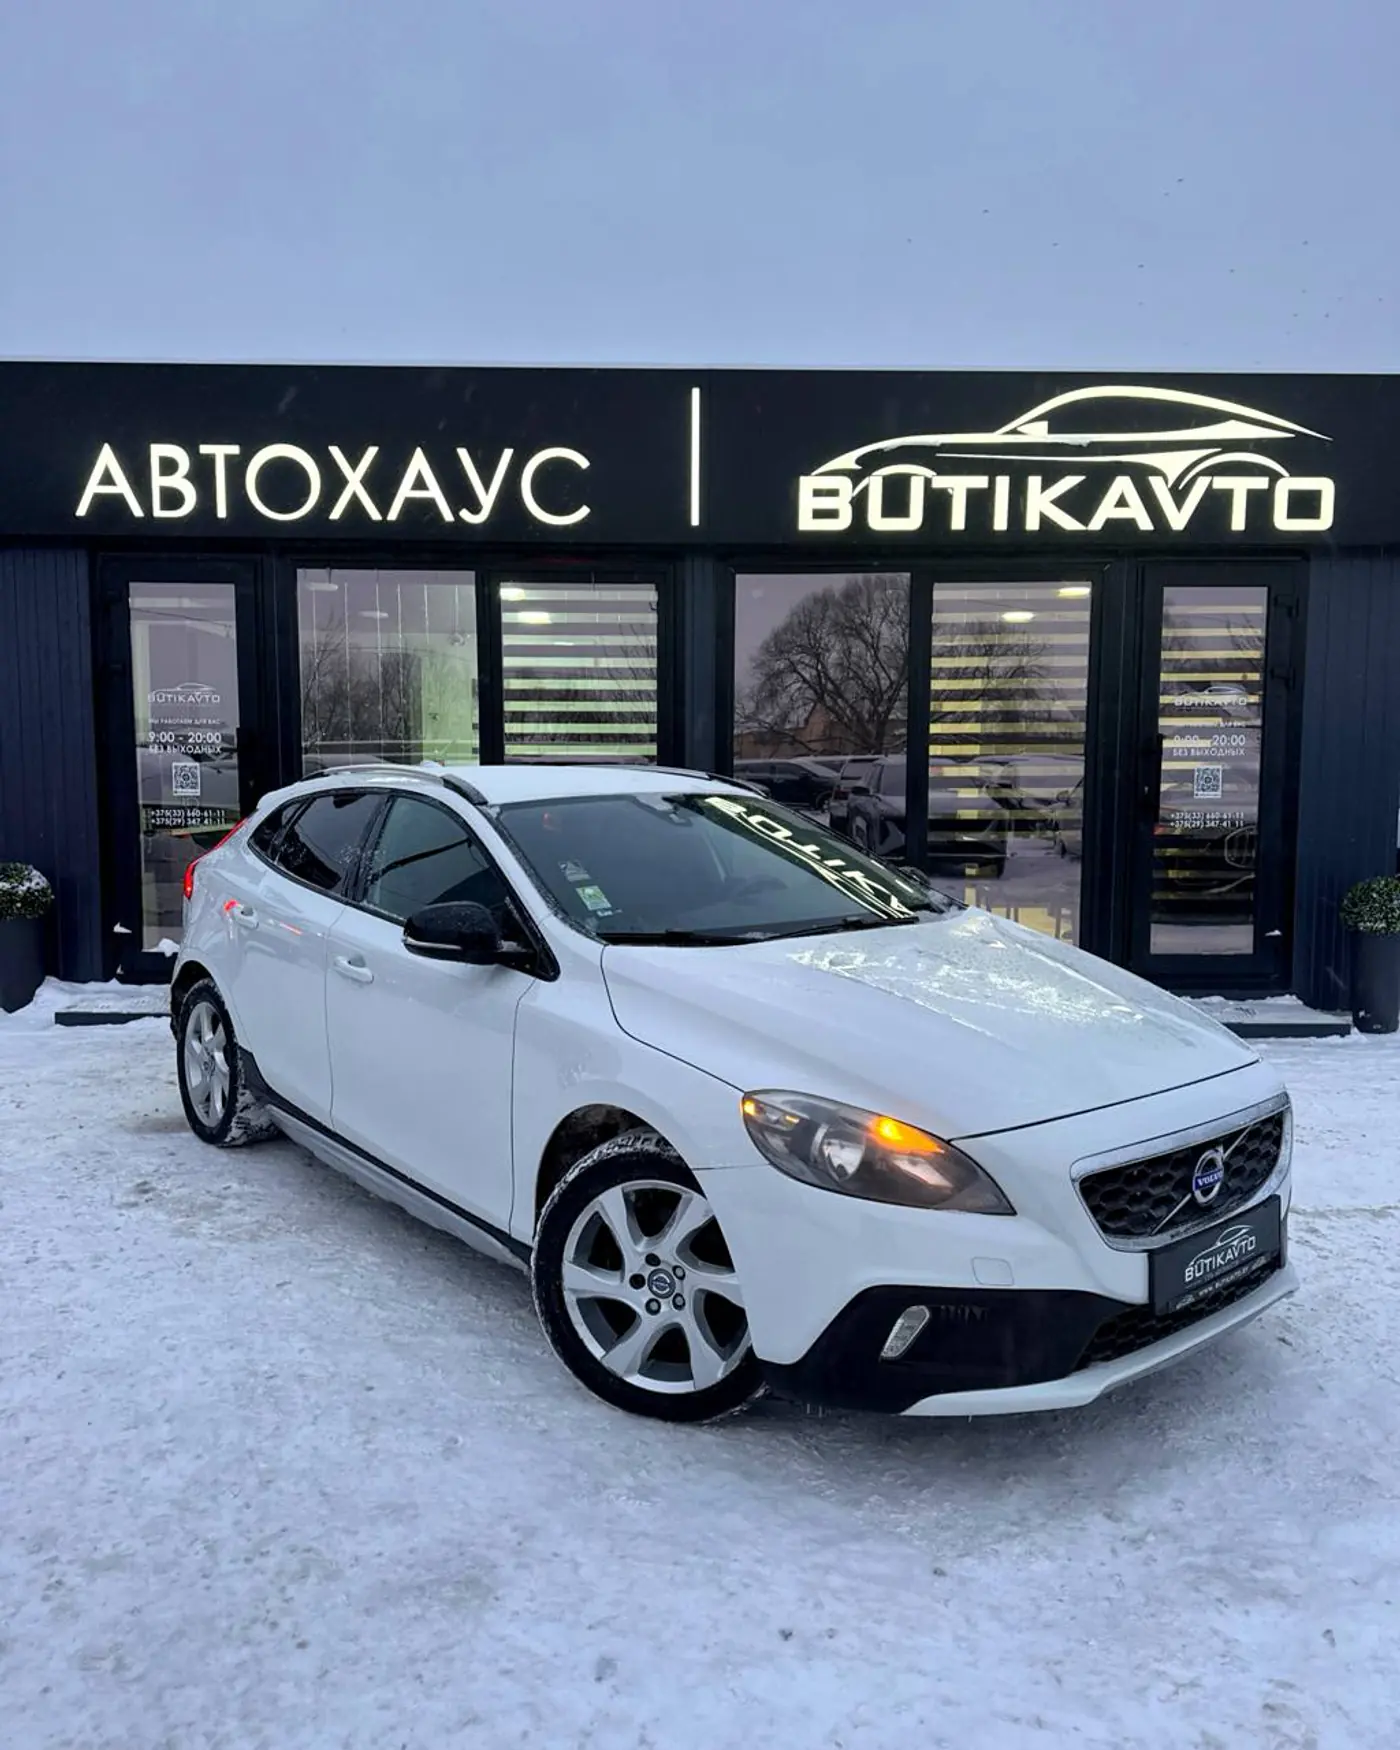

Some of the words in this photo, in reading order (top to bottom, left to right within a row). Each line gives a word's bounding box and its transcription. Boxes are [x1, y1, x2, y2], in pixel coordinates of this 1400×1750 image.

[75, 442, 591, 526] АВТОХАУС
[797, 474, 1335, 532] BUTIKAVTO
[148, 693, 221, 704] BUTIKAVTO
[148, 731, 175, 743] 9:00
[187, 731, 222, 744] 20:00
[1212, 734, 1246, 746] 20:00
[166, 744, 222, 754] ВЫХОДНЫХ
[1190, 748, 1246, 756] ВЫХОДНЫХ
[186, 817, 226, 825] 34741-11
[1205, 820, 1244, 828] 347-4111
[1184, 1235, 1257, 1282] BUTIKAVTO
